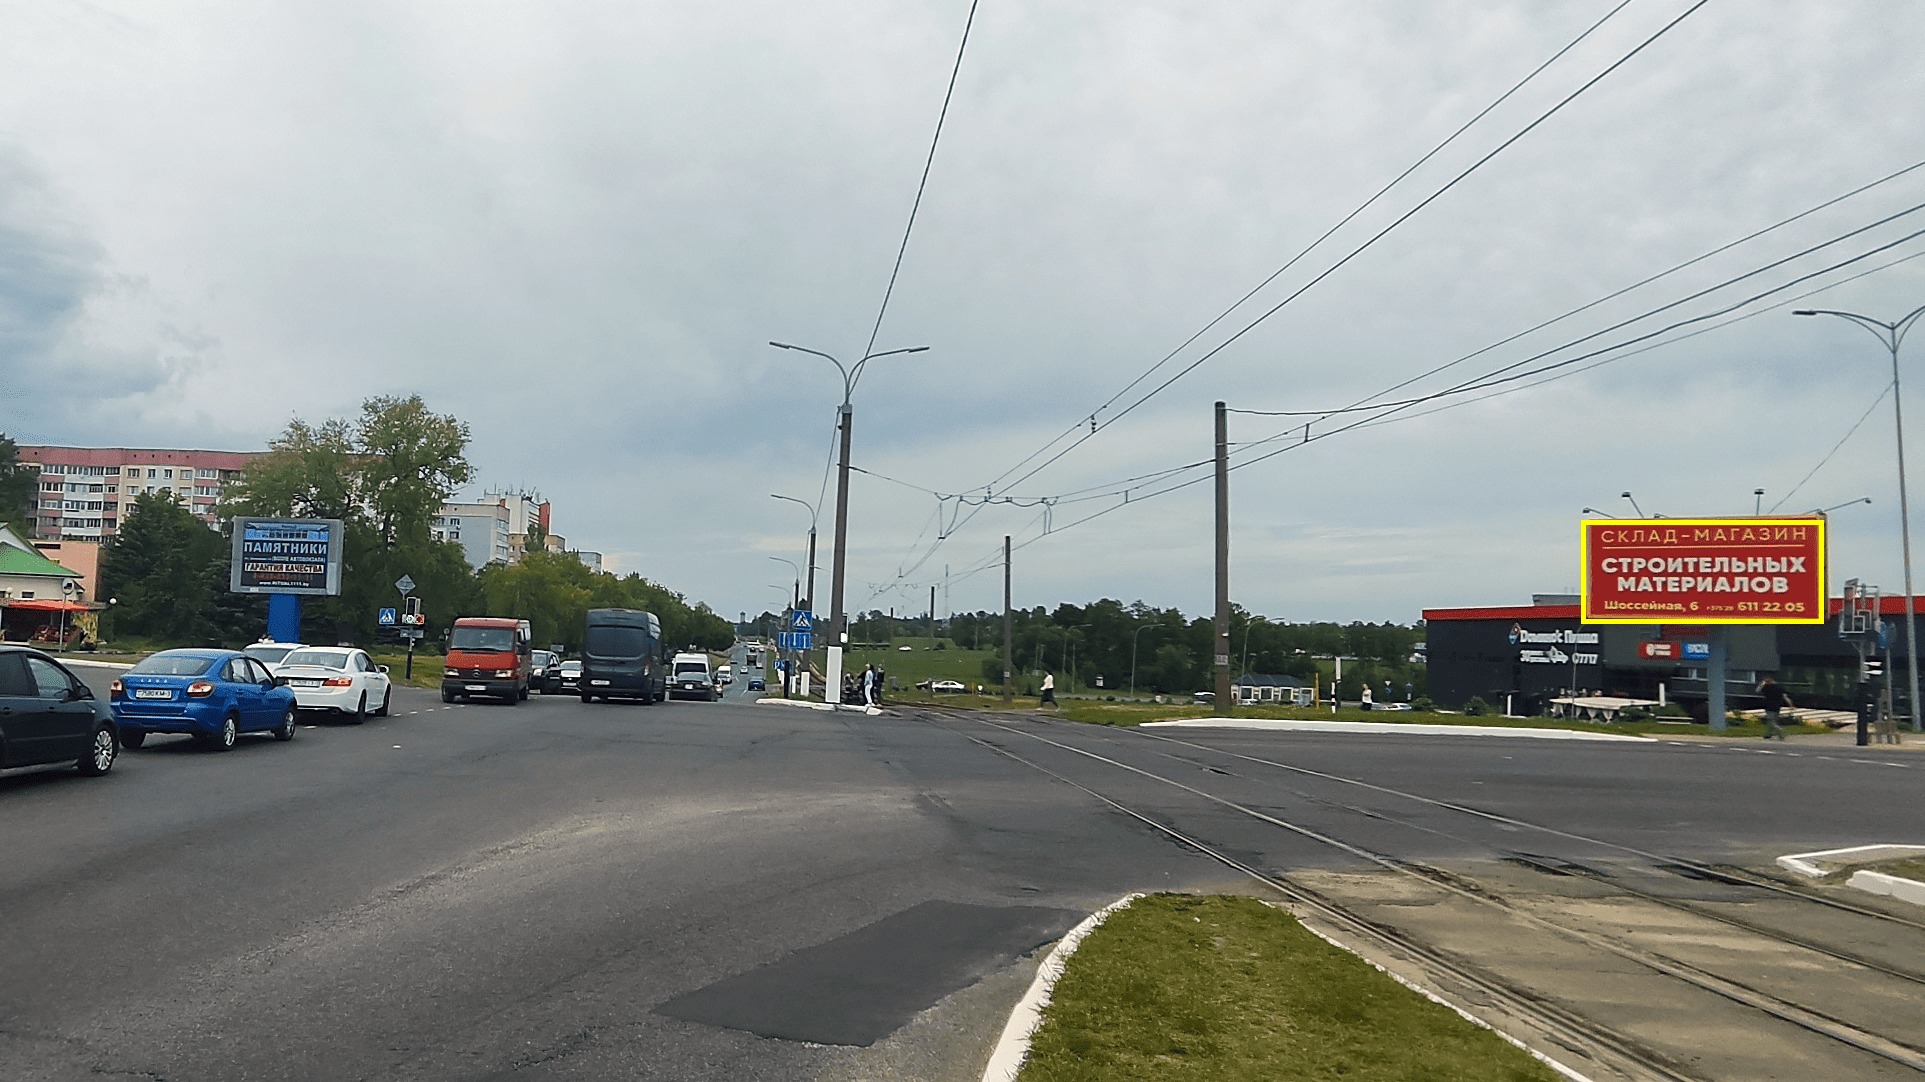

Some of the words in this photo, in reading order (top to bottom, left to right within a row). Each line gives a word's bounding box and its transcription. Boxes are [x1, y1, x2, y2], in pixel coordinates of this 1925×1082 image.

[1601, 528, 1806, 544] СКЛАД-МАГАЗИН
[244, 542, 327, 554] ПАМЯТНИКИ
[246, 563, 284, 572] ГАРАНТИЯ
[285, 564, 323, 573] КАЧЕСТВА
[1601, 557, 1806, 573] СТРОИТЕЛЬНЫХ
[1617, 576, 1789, 593] МАТЕРИАЛОВ
[1604, 600, 1687, 612] Шоссейная,
[1689, 602, 1699, 611] 6
[1738, 602, 1759, 612] 611
[1762, 602, 1781, 612] 22
[1784, 602, 1806, 612] 05
